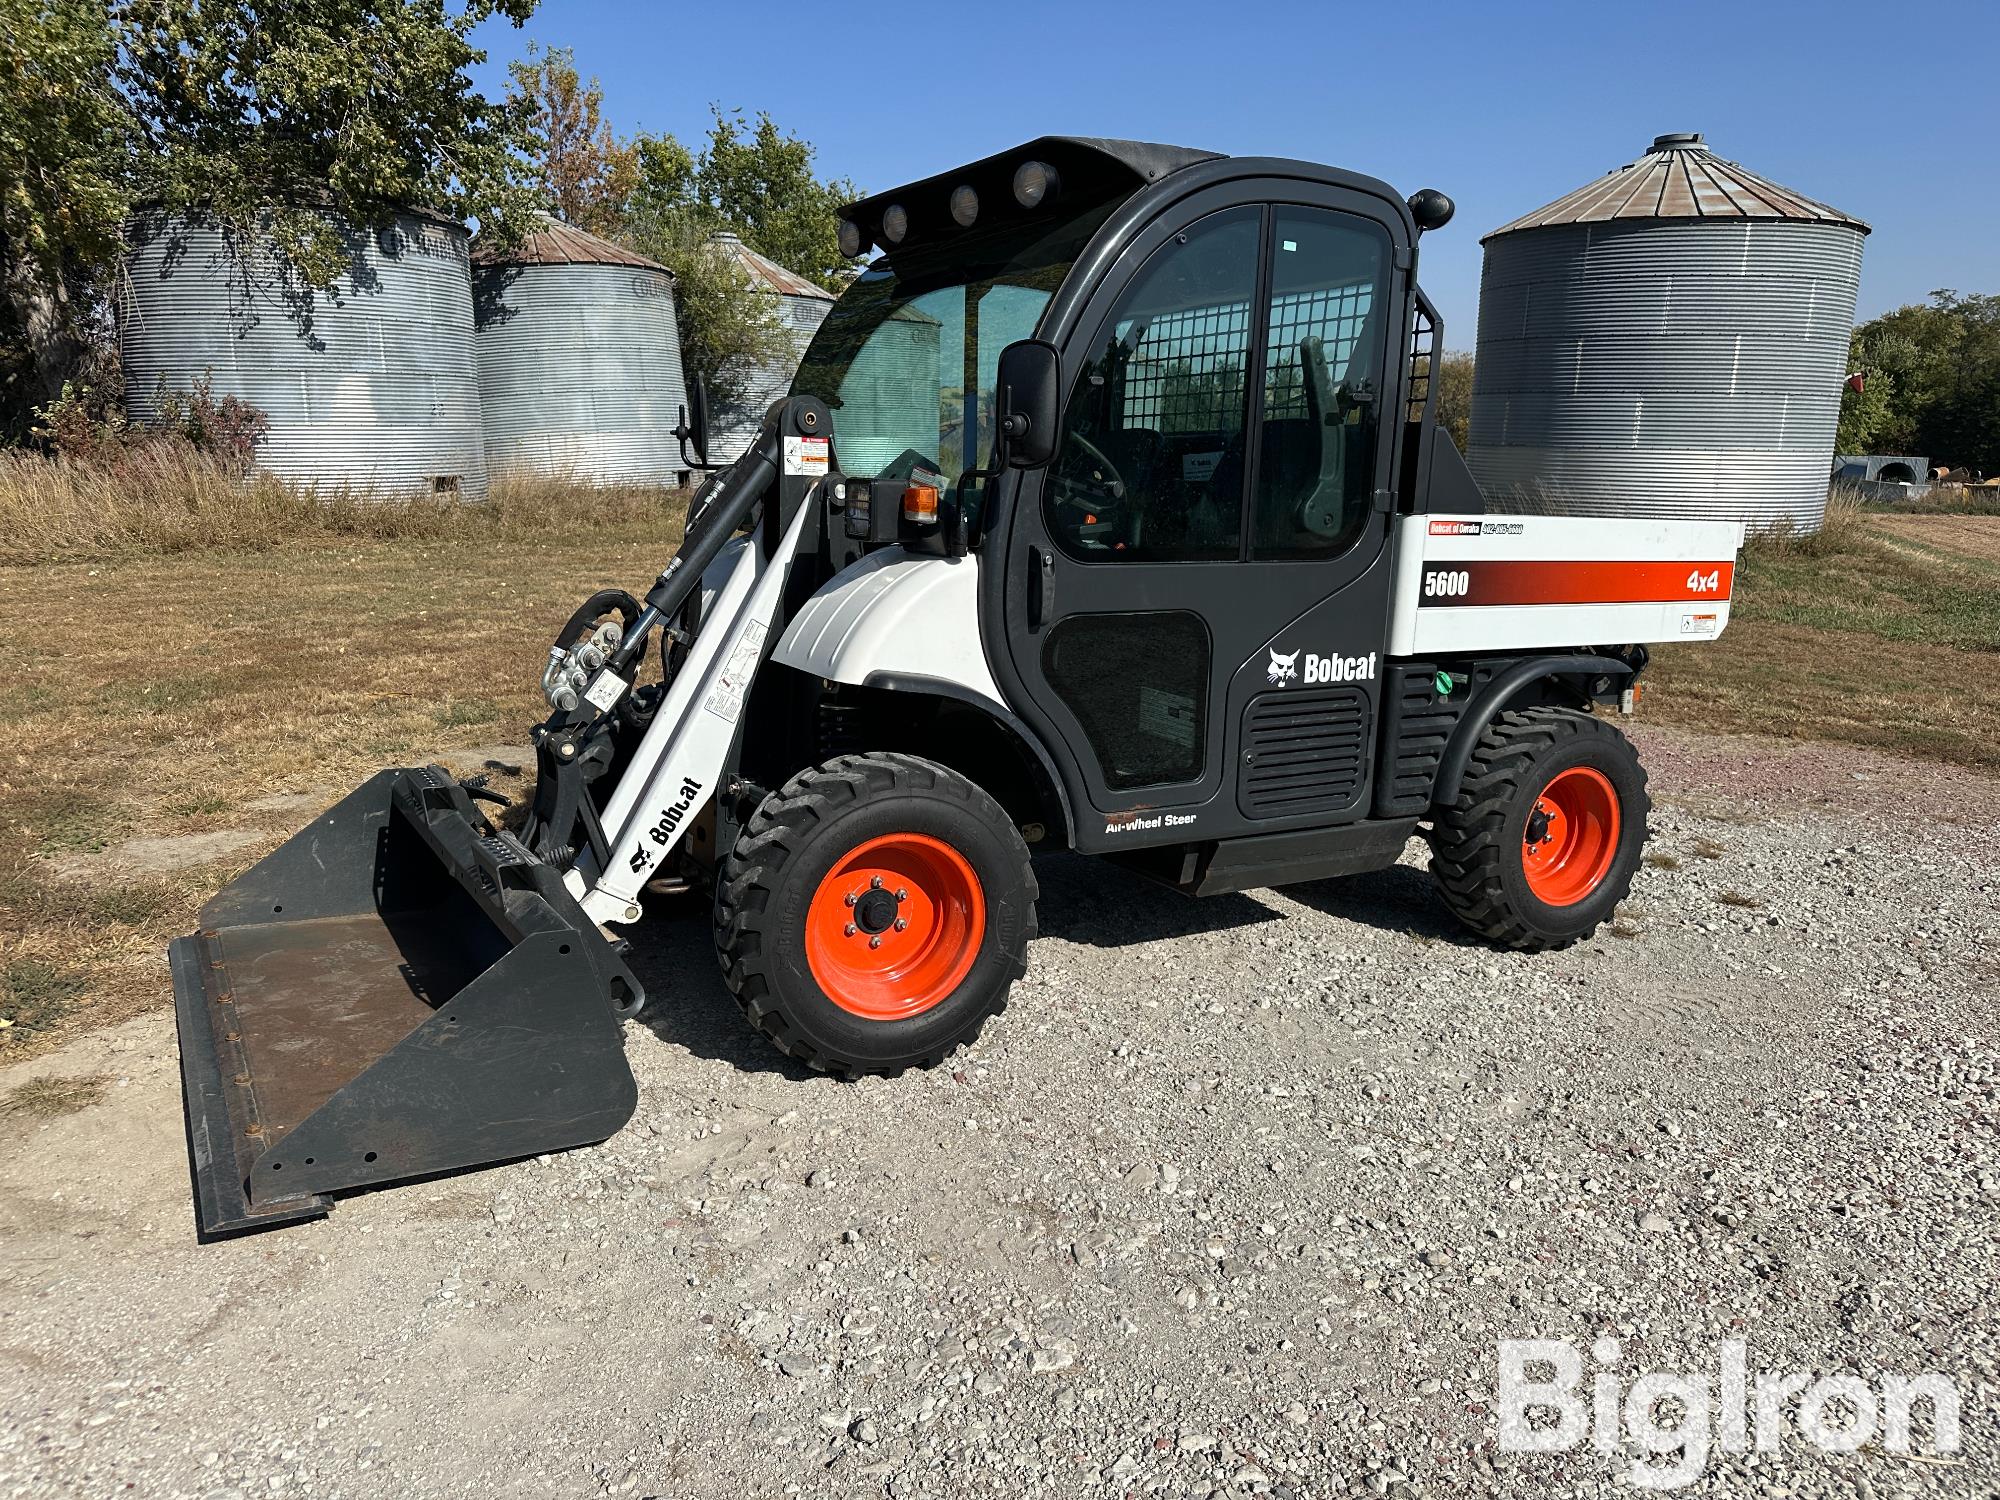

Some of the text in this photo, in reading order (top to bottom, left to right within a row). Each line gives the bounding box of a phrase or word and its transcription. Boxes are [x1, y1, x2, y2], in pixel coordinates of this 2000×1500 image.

[1430, 523, 1452, 534] Bobcat
[1452, 523, 1460, 535] of
[1459, 523, 1480, 534] Omaha
[1425, 571, 1469, 596] 5600
[1687, 570, 1719, 592] 4x4
[1304, 652, 1376, 683] Bobcat
[649, 776, 703, 847] Bobcat
[1164, 814, 1197, 826] Steer
